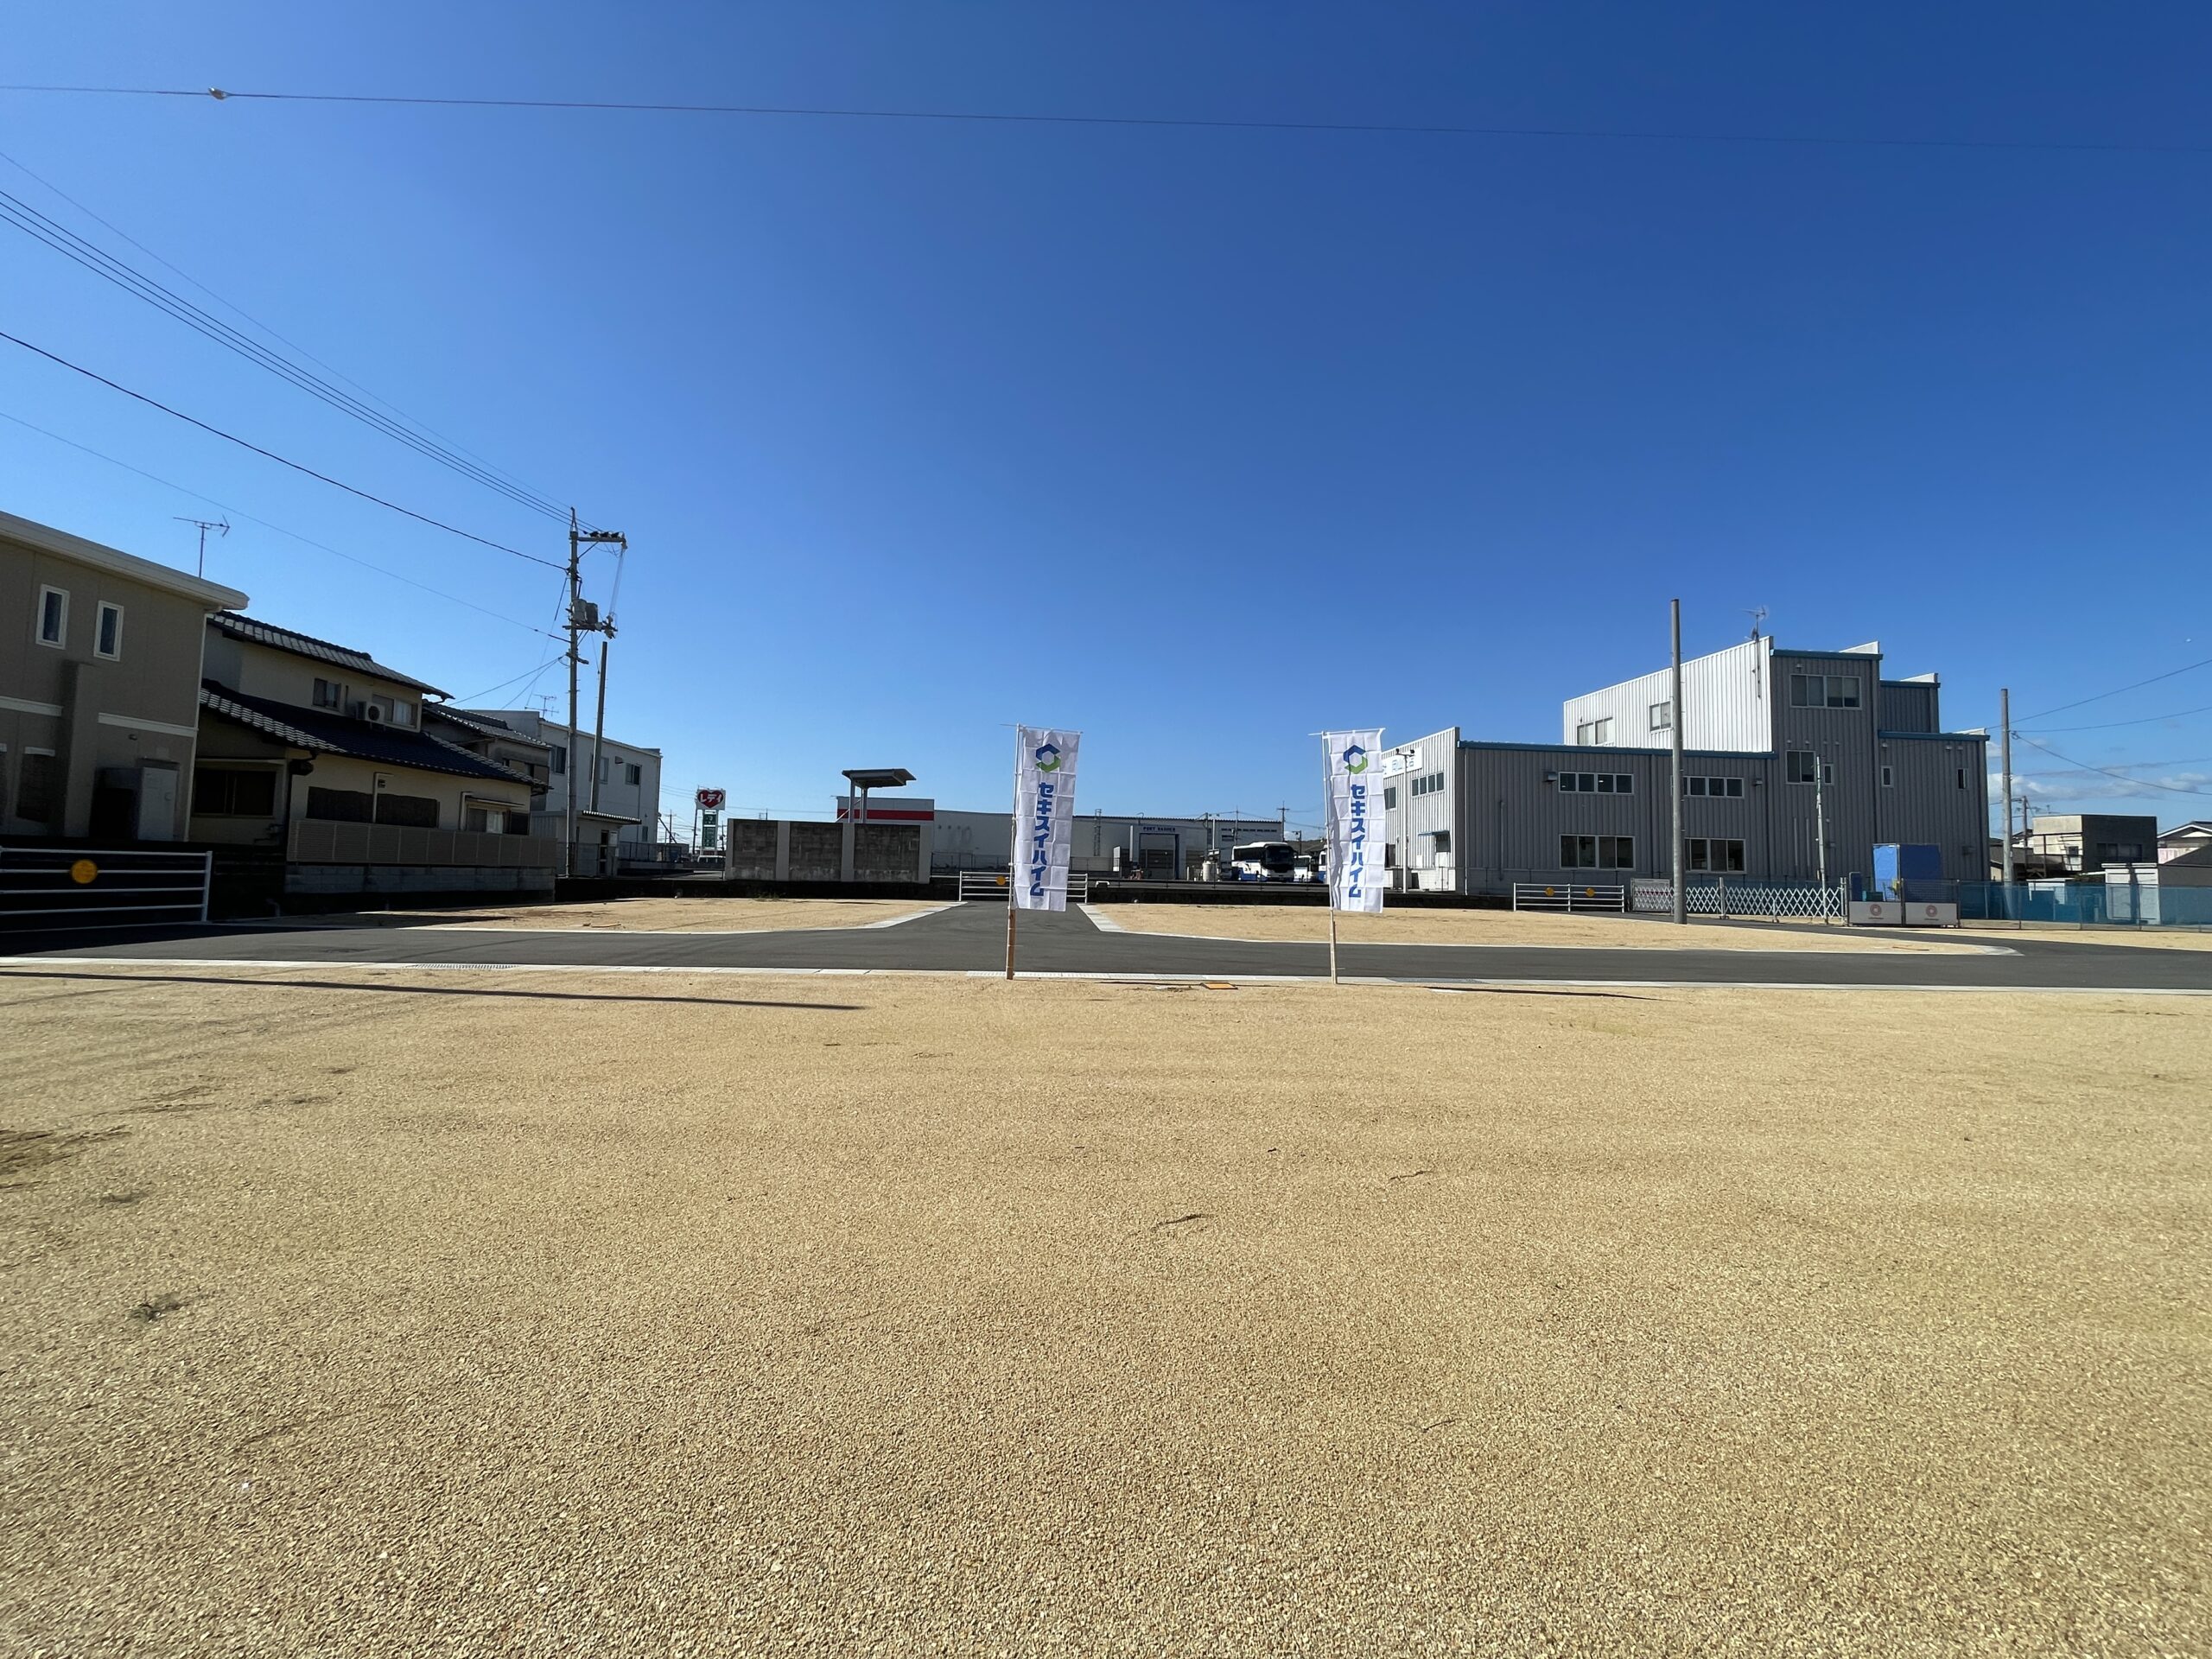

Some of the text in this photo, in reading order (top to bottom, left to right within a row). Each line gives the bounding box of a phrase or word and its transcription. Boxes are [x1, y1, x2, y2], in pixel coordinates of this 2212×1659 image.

[700, 793, 722, 803] レディ
[1030, 782, 1054, 897] セキスイハイム
[1349, 784, 1366, 898] セキスイハイム
